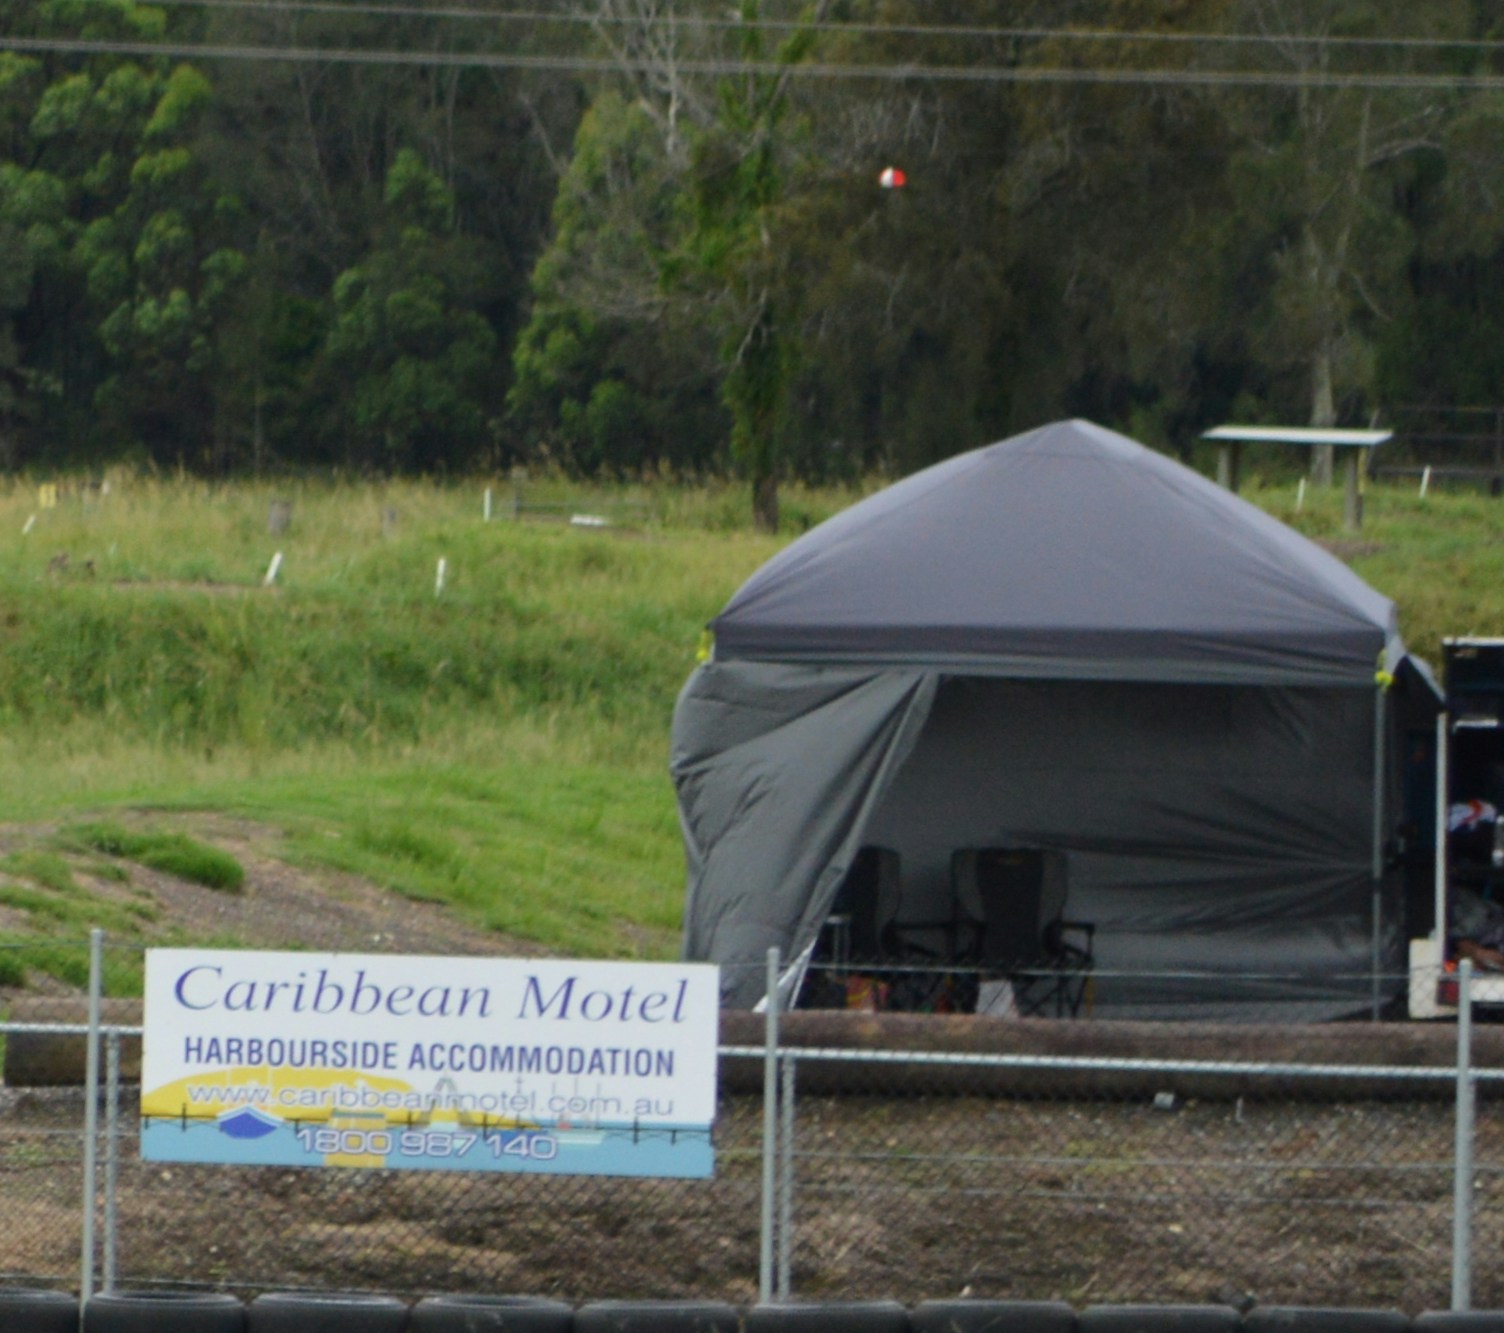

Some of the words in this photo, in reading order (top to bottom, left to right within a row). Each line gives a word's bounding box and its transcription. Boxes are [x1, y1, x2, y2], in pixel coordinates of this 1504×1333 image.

[174, 965, 492, 1018] Caribbean
[516, 975, 689, 1024] Motel
[184, 1036, 398, 1070] HARBOURSIDE
[408, 1043, 674, 1076] ACCOMMODATION
[188, 1080, 674, 1116] www.caribbeanmotel.com.au
[297, 1128, 392, 1156] 1800
[400, 1131, 477, 1157] 987
[486, 1134, 559, 1160] 140
